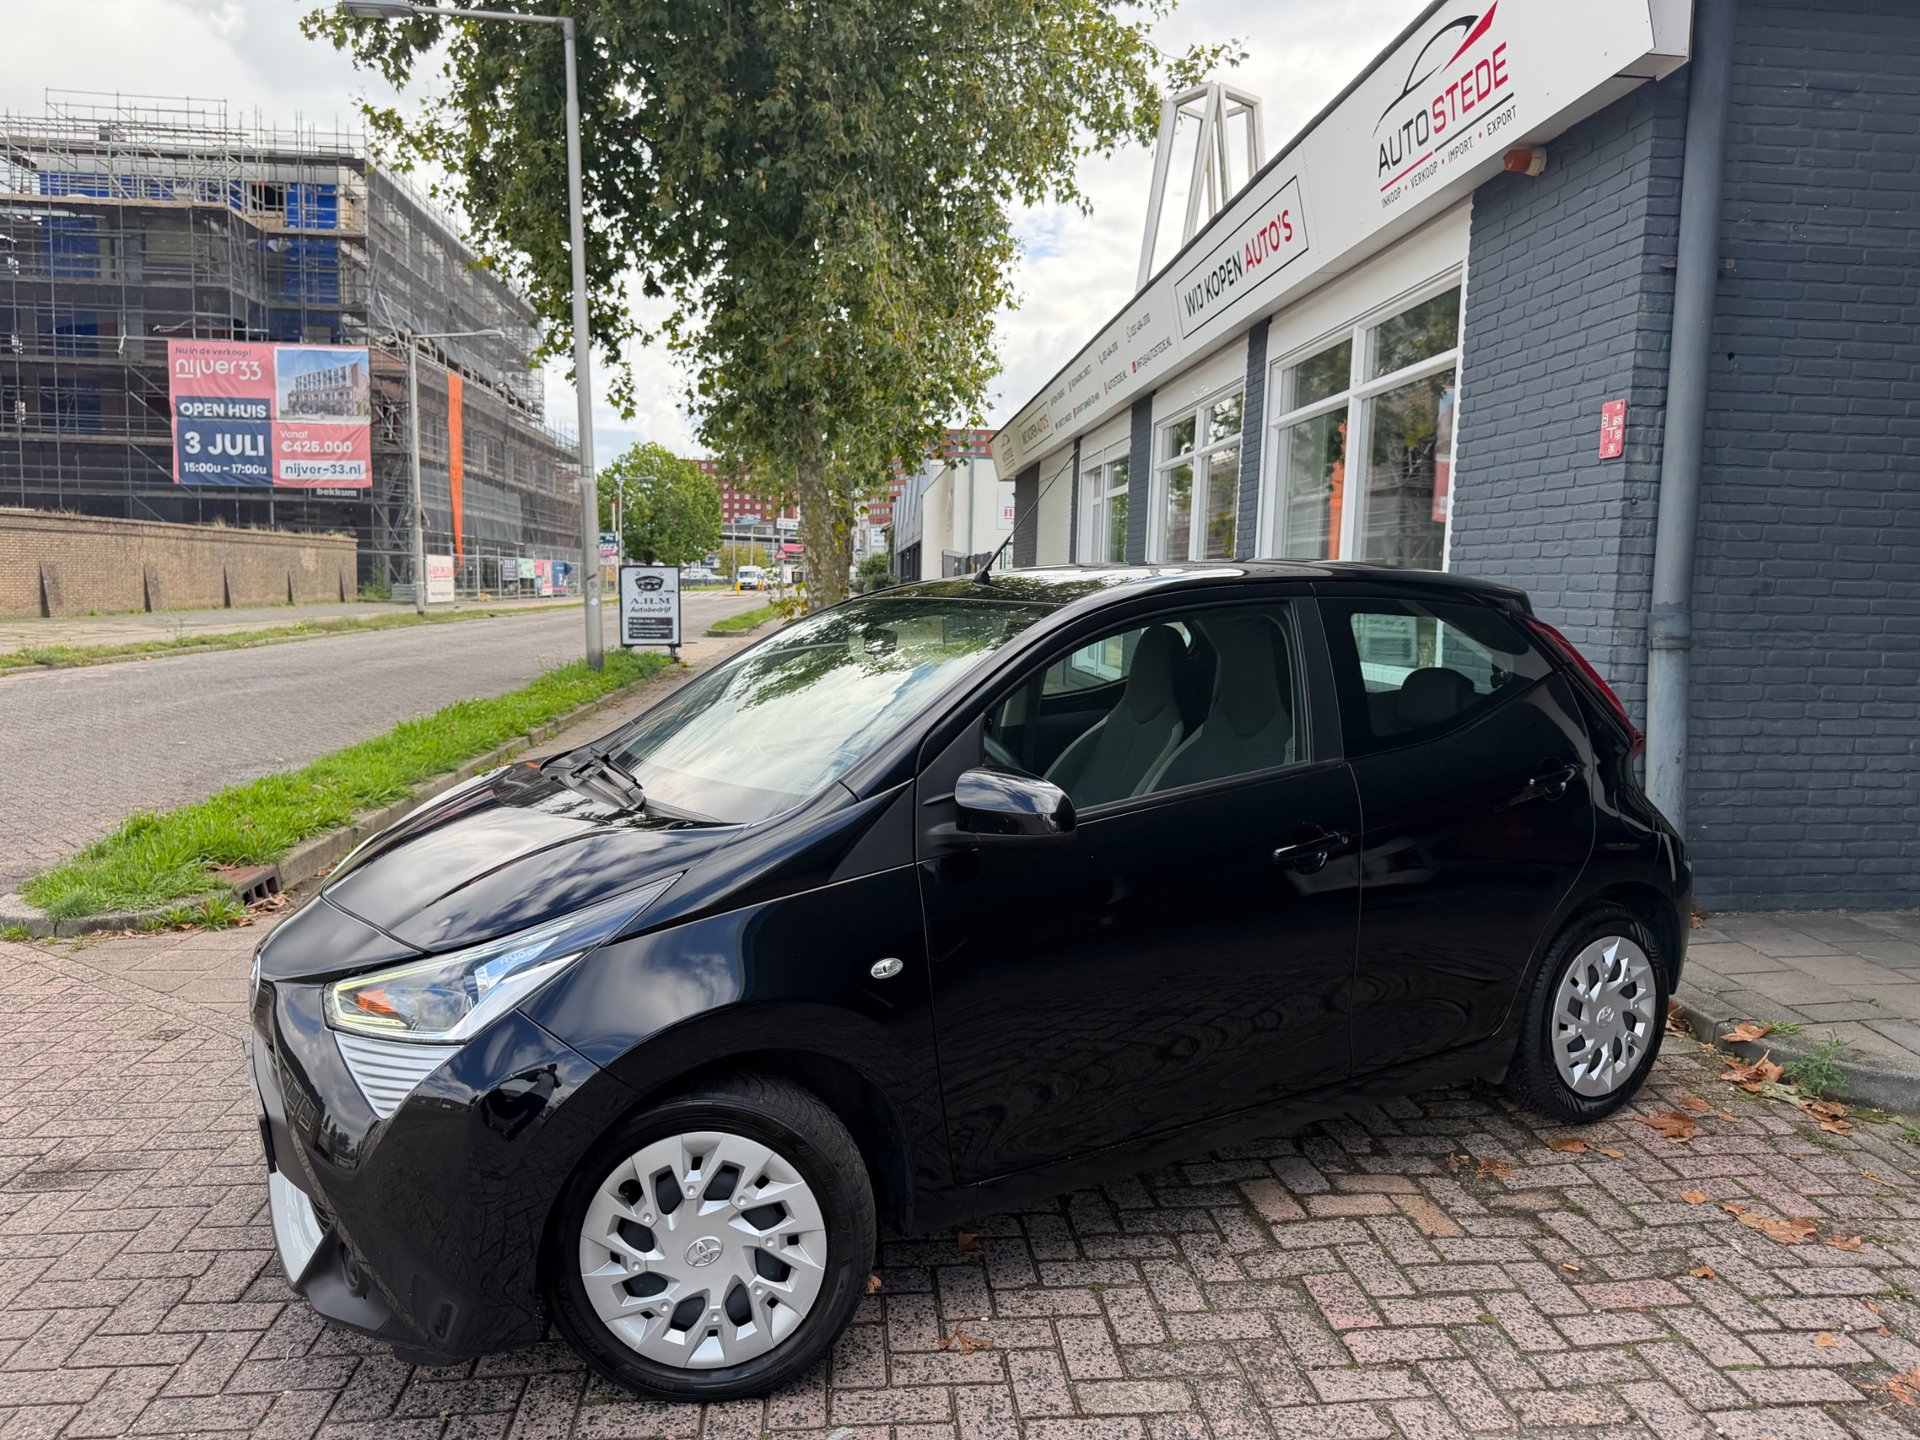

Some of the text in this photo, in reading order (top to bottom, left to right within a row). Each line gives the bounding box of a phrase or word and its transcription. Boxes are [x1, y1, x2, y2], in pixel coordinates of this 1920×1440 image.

[1382, 105, 1517, 209] INKOOP VERKOOP IMPORT EXPORT
[1183, 208, 1293, 318] WIJ KOPEN AUTO'S
[175, 346, 188, 355] Nu
[189, 347, 198, 355] in
[200, 348, 210, 356] de
[179, 402, 267, 418] OPEN HUIS
[280, 430, 308, 439] Vanaf
[184, 431, 265, 456] 3 JULI
[281, 440, 352, 453] €425.000
[184, 462, 221, 473] 15:00u
[232, 463, 267, 475] 17:00u
[285, 463, 361, 477] nijver-33.nl
[630, 606, 671, 614] Autobedrijf
